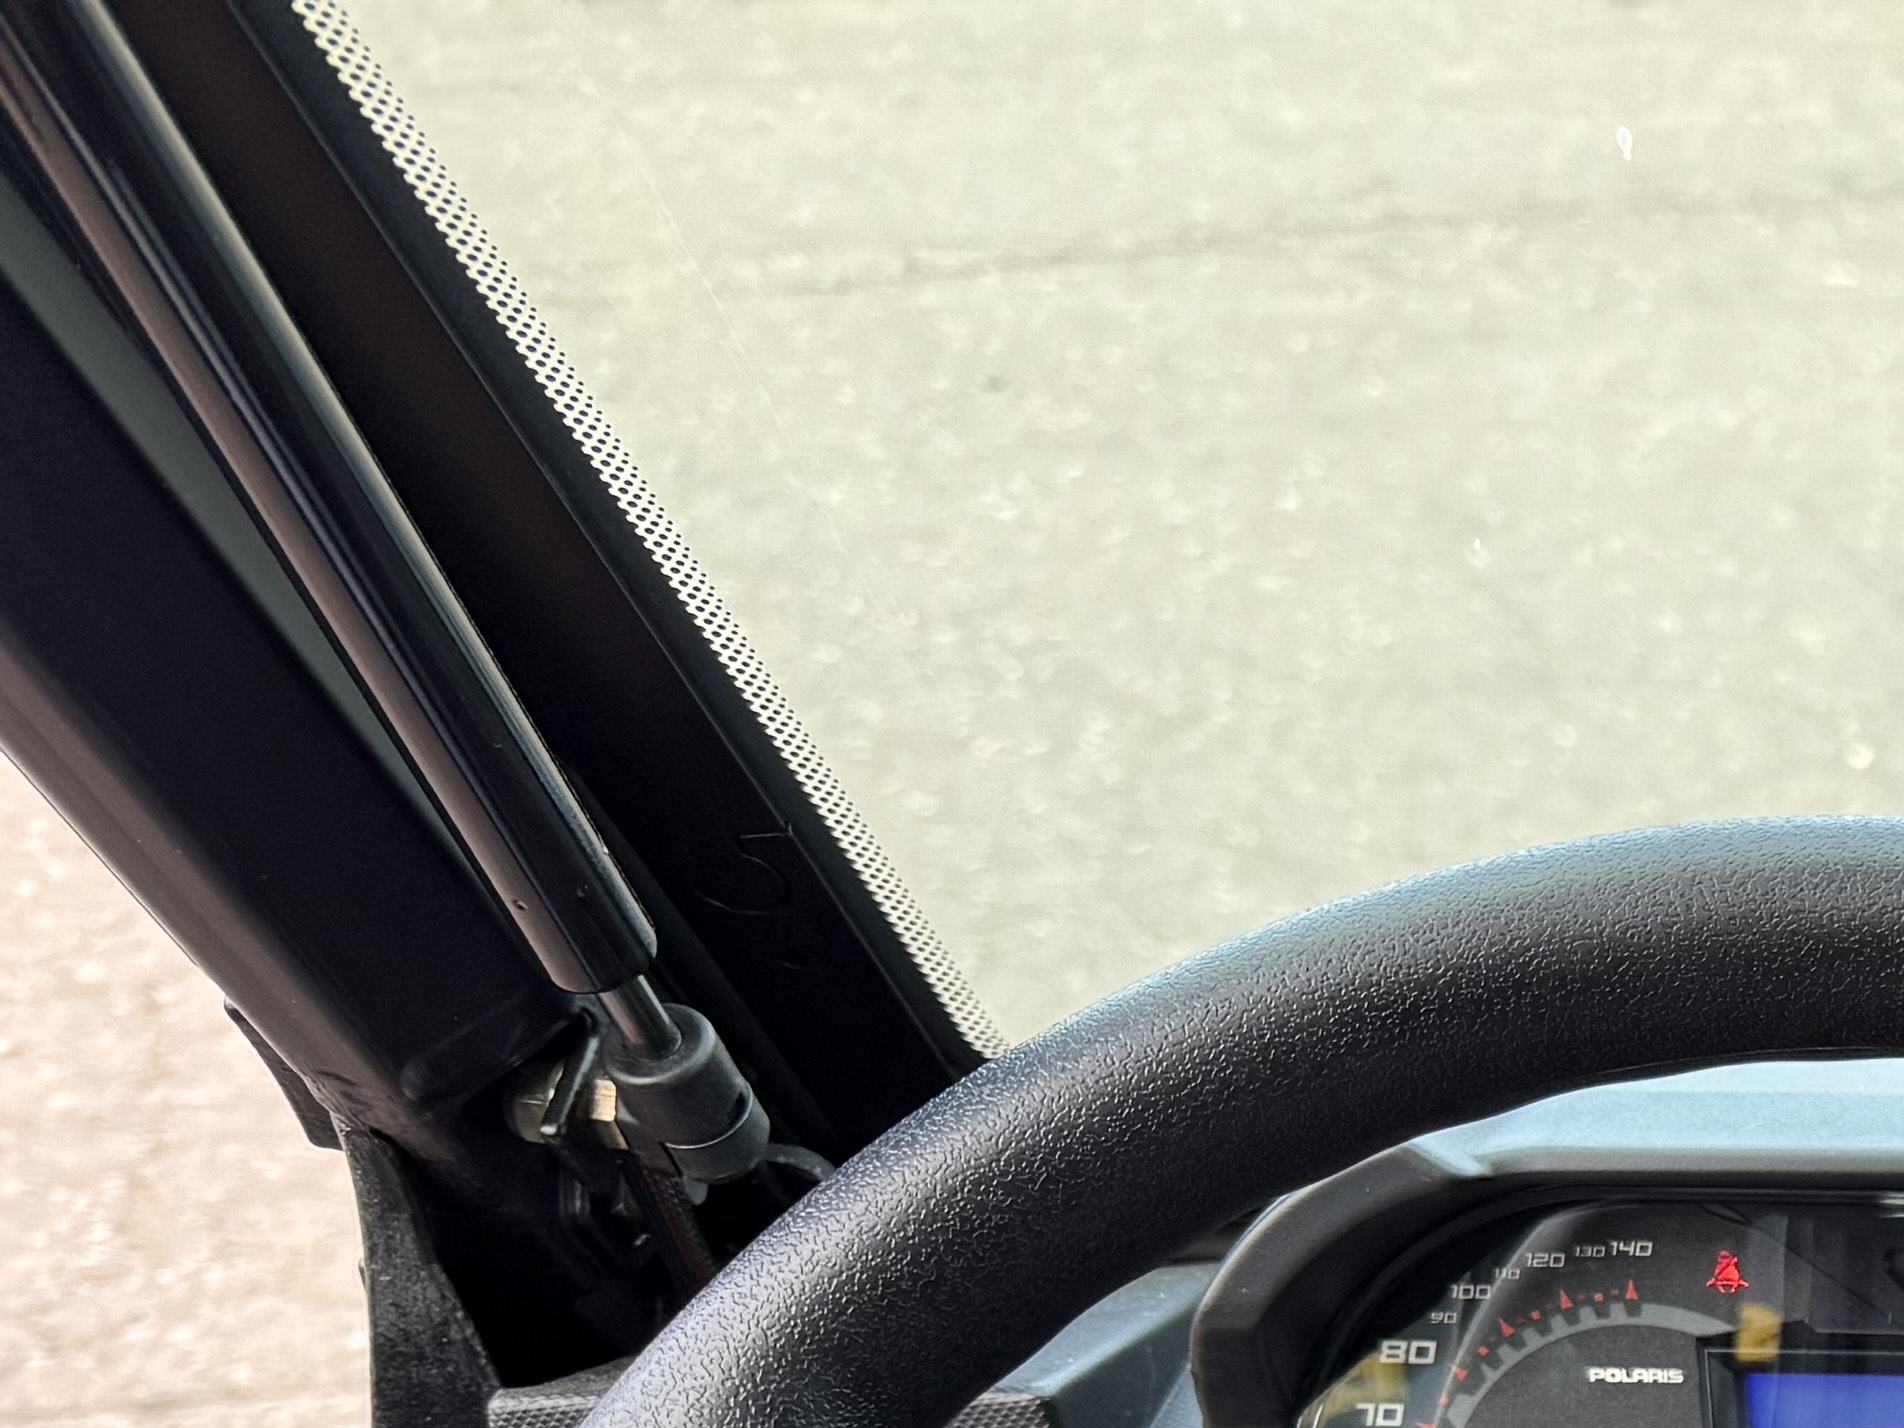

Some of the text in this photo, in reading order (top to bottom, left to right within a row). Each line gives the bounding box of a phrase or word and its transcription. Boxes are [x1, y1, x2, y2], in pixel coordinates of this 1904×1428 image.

[1576, 1245, 1606, 1258] 130
[1609, 1240, 1653, 1257] 140
[1525, 1253, 1566, 1268] 120
[1495, 1268, 1521, 1280] 110
[1450, 1284, 1492, 1300] 100
[1430, 1311, 1457, 1324] 90
[1379, 1339, 1437, 1364] 80
[1587, 1366, 1684, 1384] POLARIS
[1355, 1402, 1405, 1427] 70
